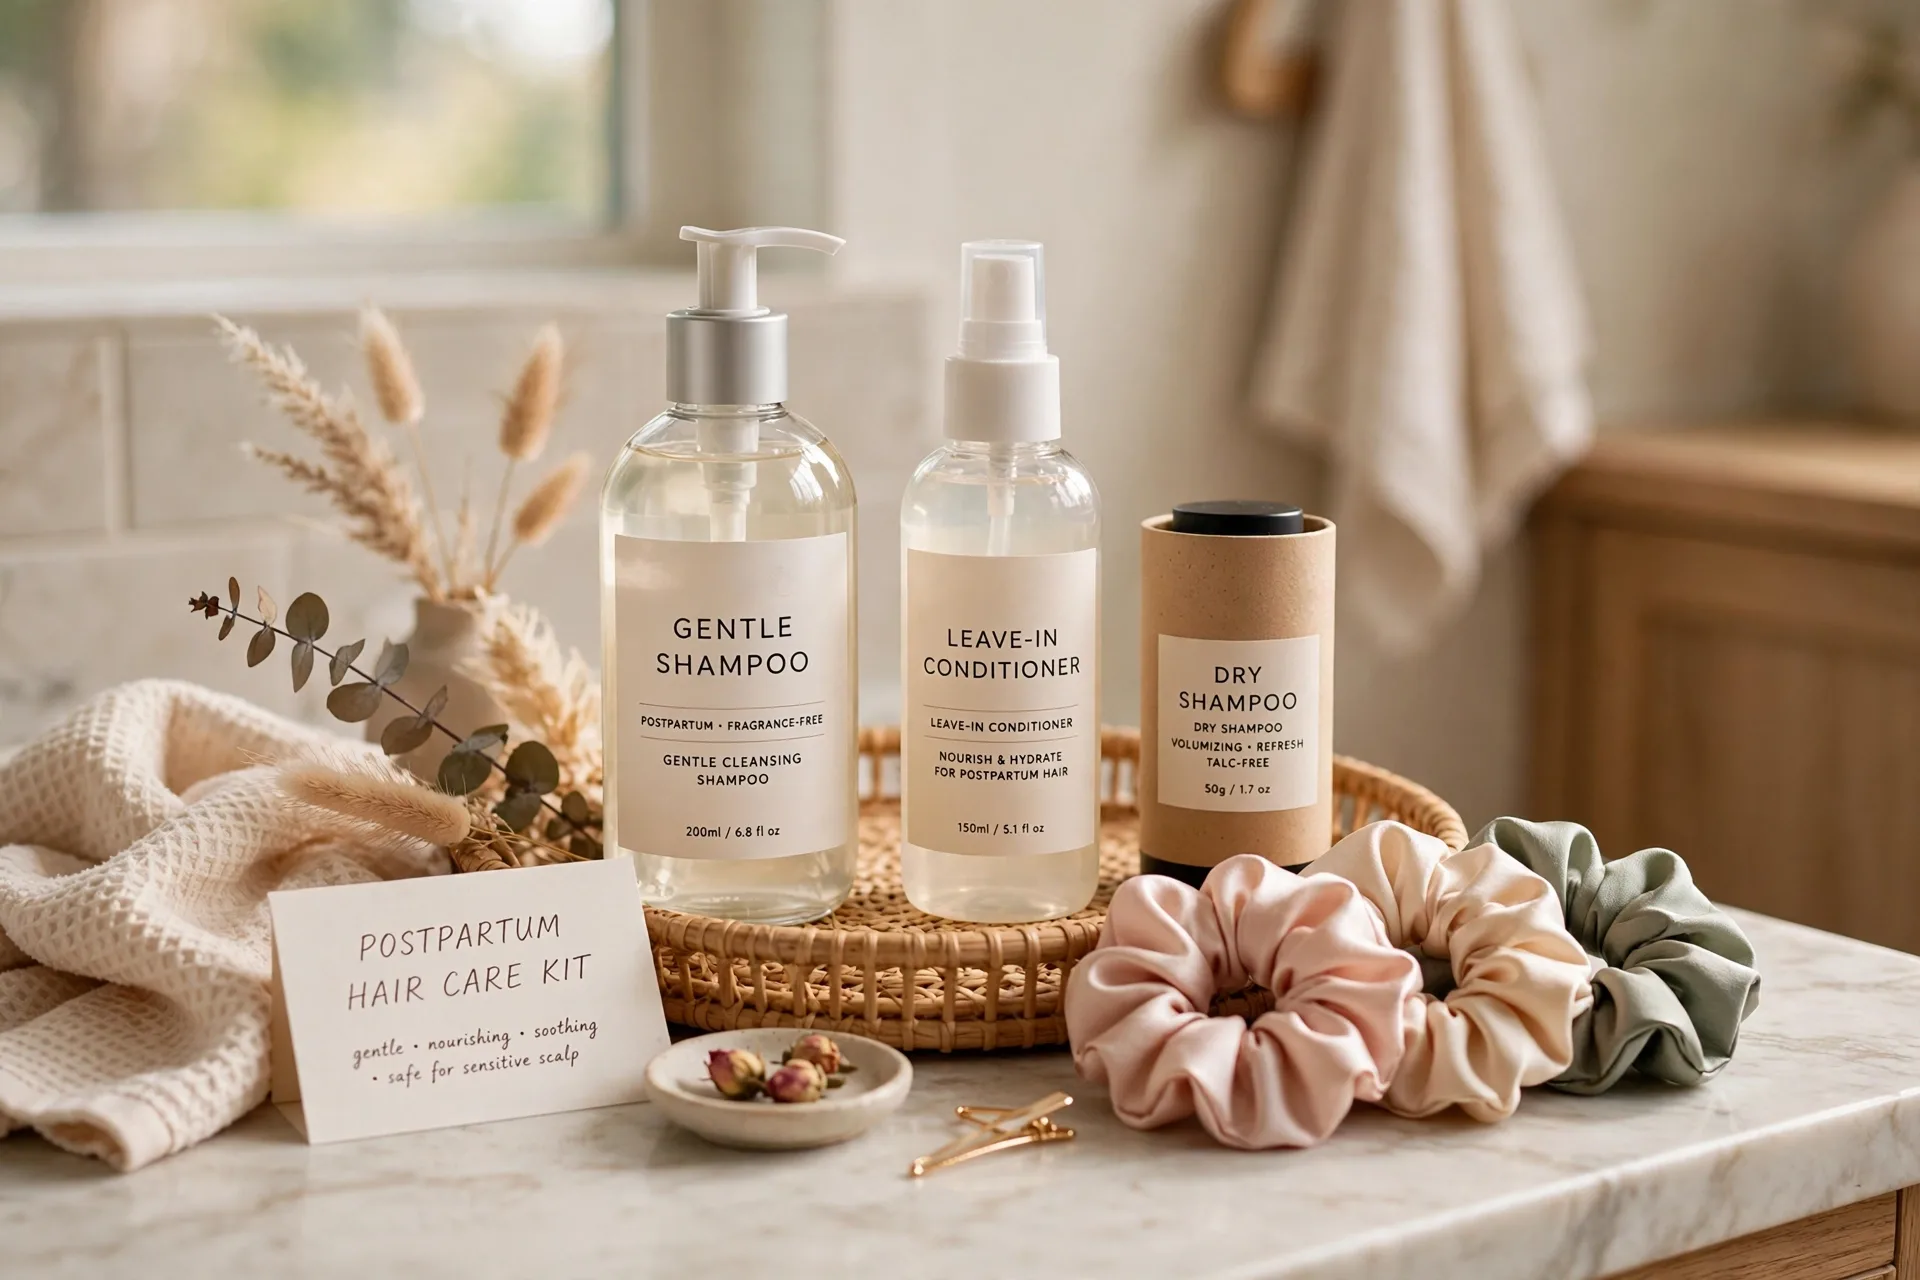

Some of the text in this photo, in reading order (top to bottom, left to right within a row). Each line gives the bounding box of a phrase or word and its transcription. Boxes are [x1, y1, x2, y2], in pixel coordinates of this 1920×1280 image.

[673, 616, 792, 639] GENTLE
[947, 629, 1057, 648] LEAVE-IN
[656, 651, 809, 675] SHAMPOO
[923, 657, 1080, 679] CONDITIONER
[1214, 666, 1262, 683] DRY
[1179, 691, 1297, 711] SHAMPOO
[641, 714, 823, 731] POSTPARTUM FRAGRANCE-FREE
[930, 718, 1073, 733] LEAVE-IN CONDITIONER
[1193, 722, 1283, 734] DRY SHAMPOO
[1171, 738, 1304, 753] VOLUMIZING REFRESH
[663, 753, 802, 768] GENTLE CLEANSING
[939, 751, 1062, 766] NOURISH & HYDRATE
[1206, 758, 1270, 769] TALC-FREE
[697, 774, 769, 786] SHAMPOO
[934, 767, 1069, 781] FOR POSTPARTUM HAIR
[1204, 784, 1226, 797] 50g
[1229, 784, 1236, 796] /
[1239, 785, 1255, 795] 1.7
[686, 826, 780, 840] 200ml / 6.8 fl oz
[957, 823, 990, 834] 150ml
[992, 824, 999, 836] /
[1003, 824, 1017, 835] 5.1
[1021, 823, 1029, 834] fl
[360, 914, 560, 961] POSTPARTUM
[348, 954, 592, 1010] HAIR CARE KIT
[352, 1017, 598, 1070] gentle nourishing soothing
[388, 1044, 579, 1088] safe for sensitive scalp
